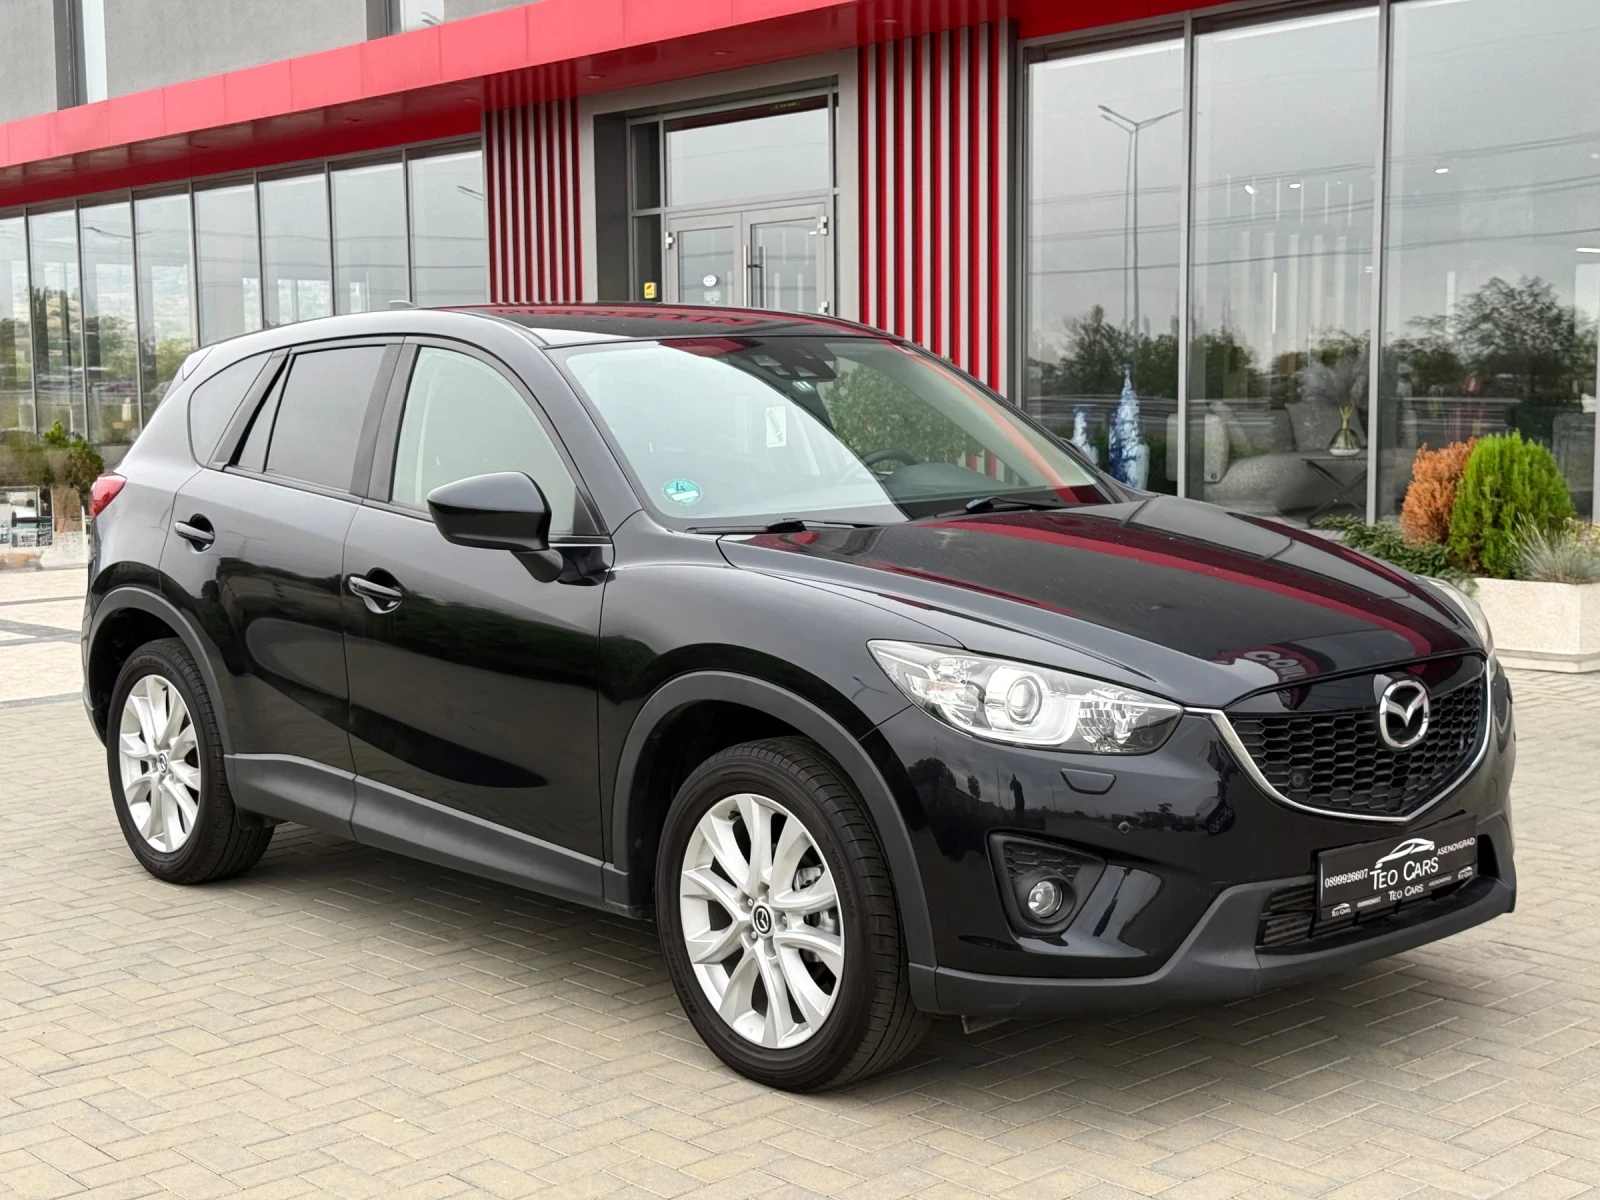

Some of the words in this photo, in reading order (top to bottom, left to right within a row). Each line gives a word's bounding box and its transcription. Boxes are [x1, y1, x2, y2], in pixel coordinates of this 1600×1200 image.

[1436, 837, 1475, 856] ASENOVGRAD
[1324, 868, 1369, 888] 0899926607
[1369, 869, 1398, 890] TEO
[1403, 856, 1439, 881] CARS
[1388, 890, 1402, 901] TEO
[1404, 884, 1424, 897] CARS
